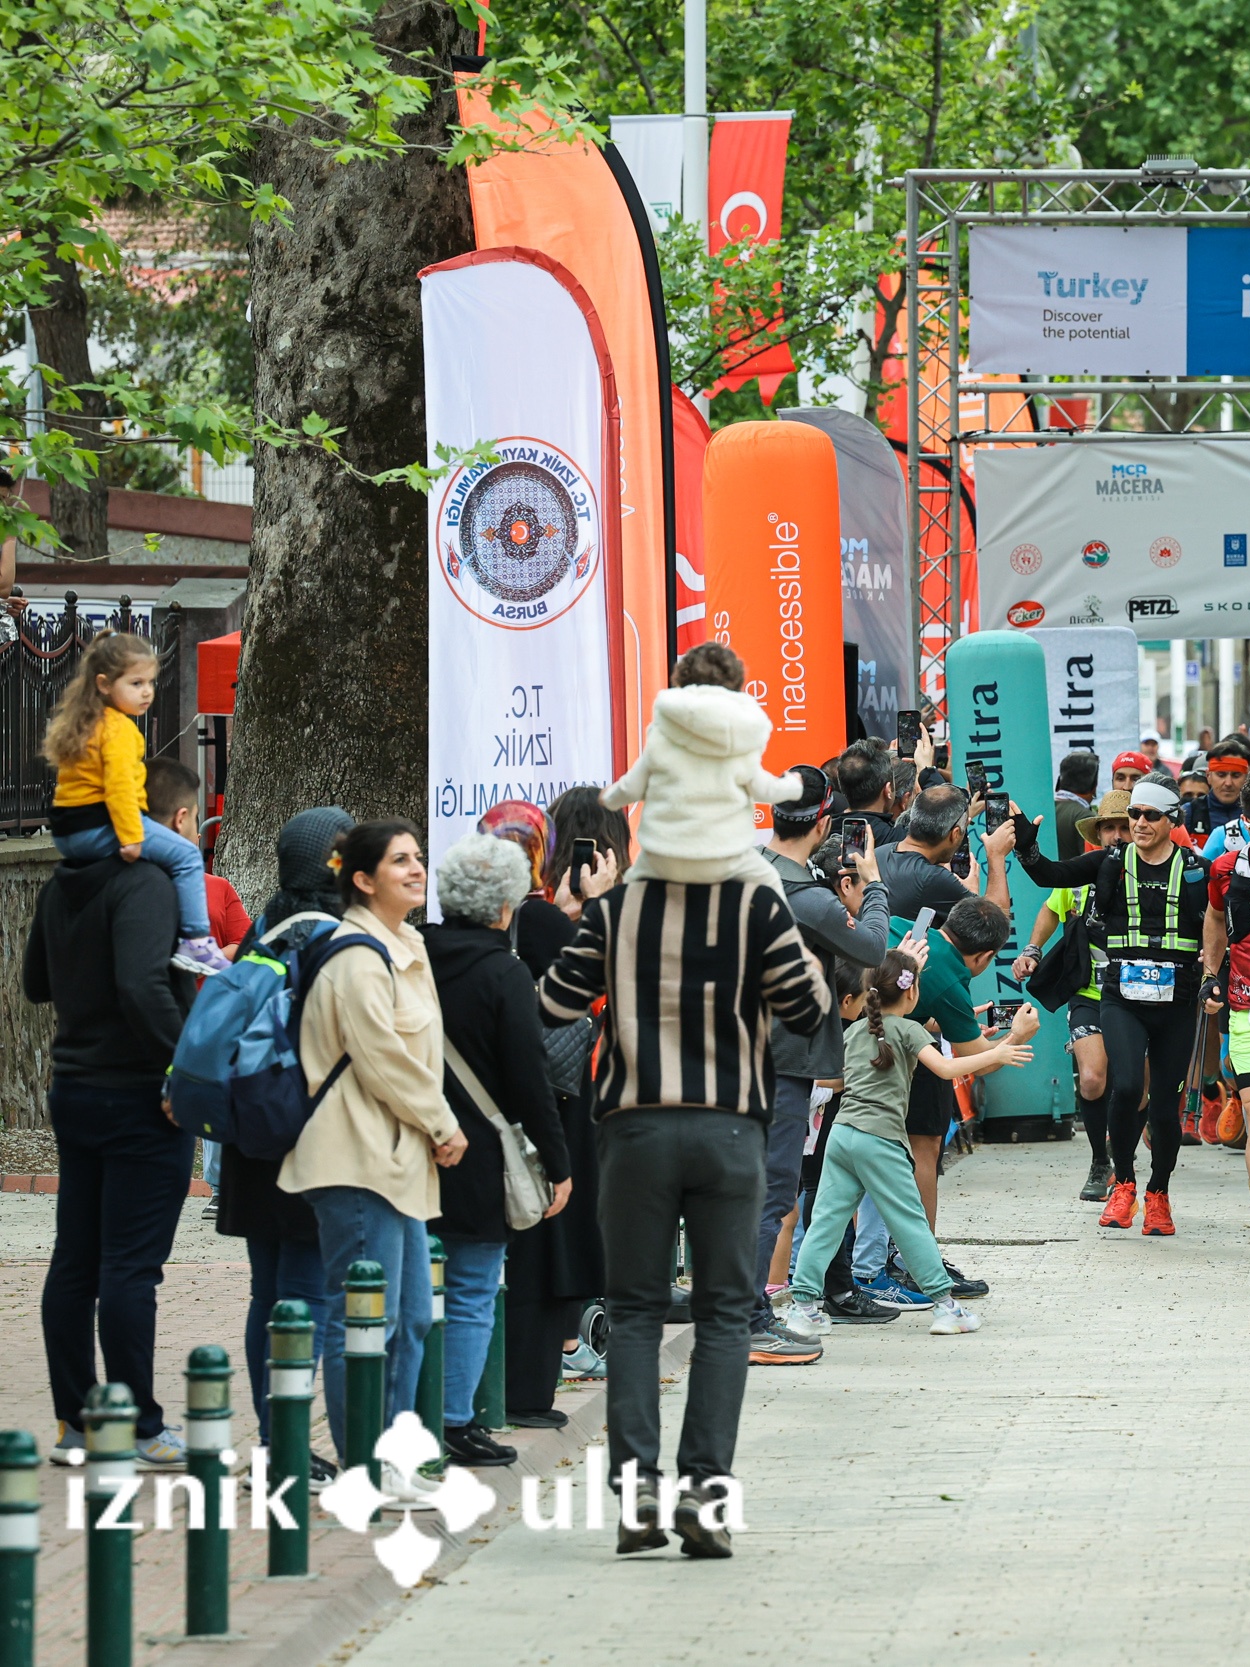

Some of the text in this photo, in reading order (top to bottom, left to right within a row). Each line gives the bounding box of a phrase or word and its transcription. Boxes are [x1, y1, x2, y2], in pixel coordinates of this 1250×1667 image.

[1037, 271, 1149, 305] Turkey
[1043, 309, 1103, 322] Discover
[1043, 326, 1131, 341] the potential
[1111, 463, 1148, 479] MCR
[1095, 478, 1165, 496] MACERA
[1128, 599, 1180, 623] PETZL
[1141, 968, 1161, 981] 39
